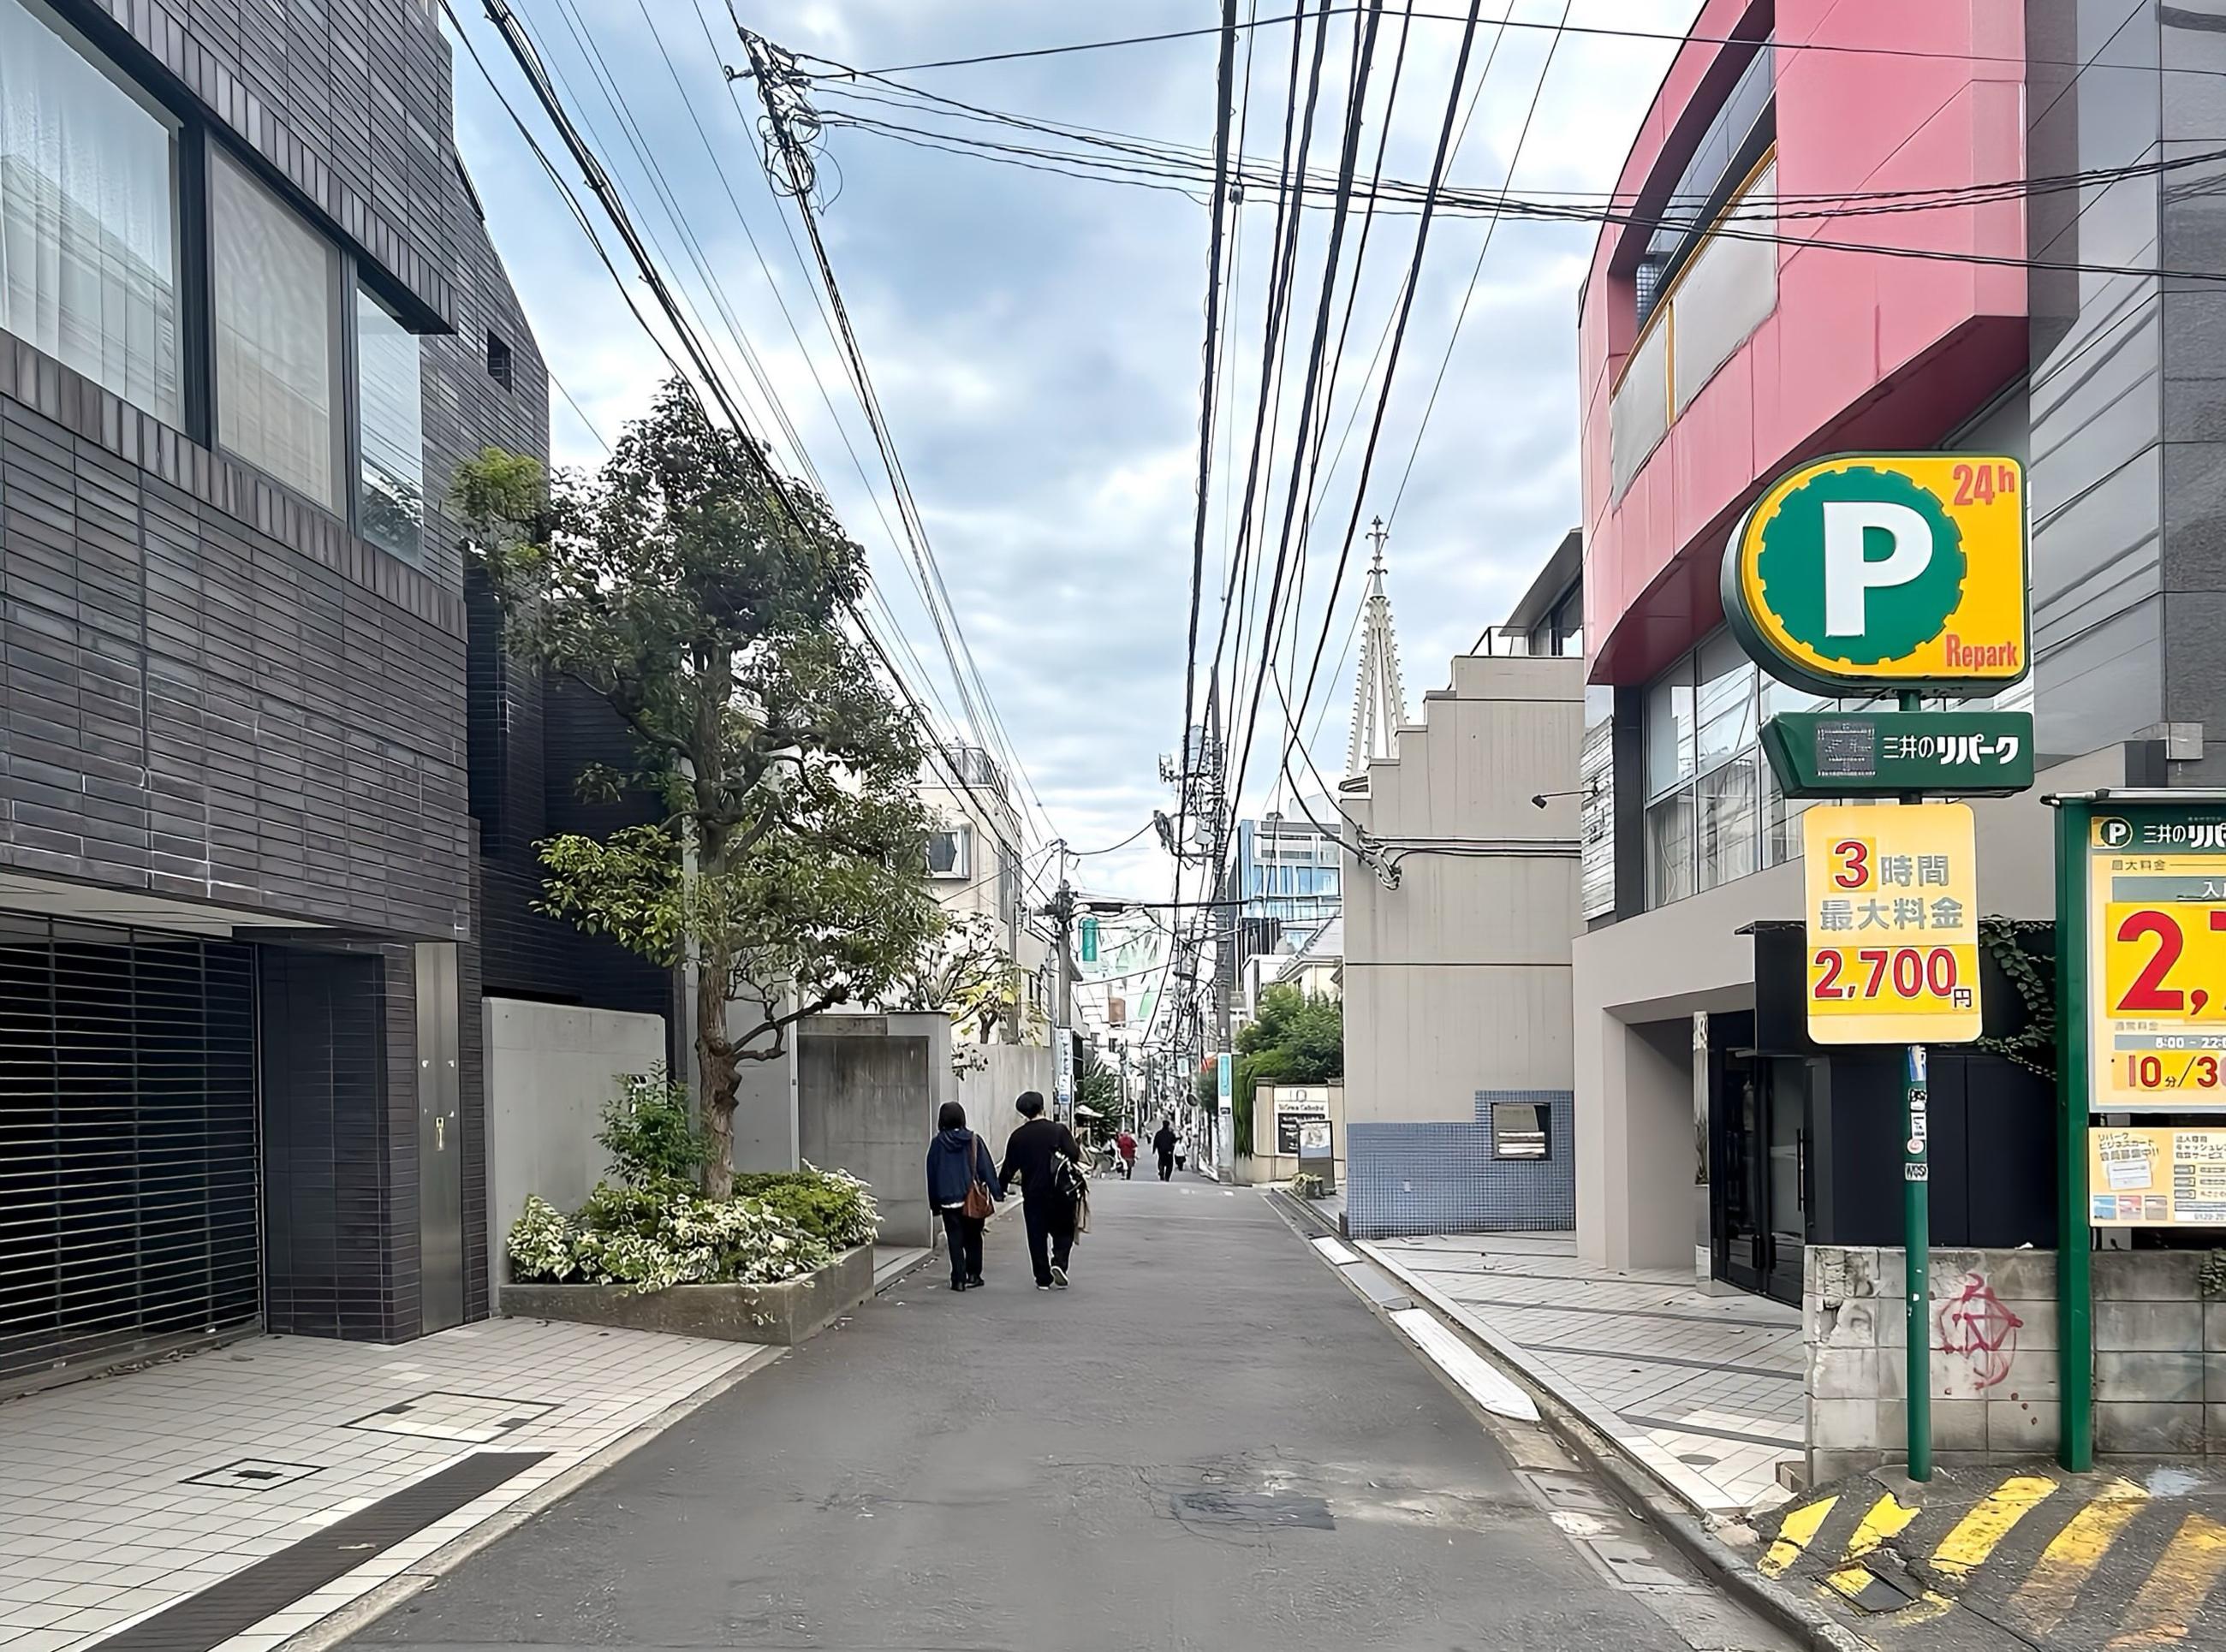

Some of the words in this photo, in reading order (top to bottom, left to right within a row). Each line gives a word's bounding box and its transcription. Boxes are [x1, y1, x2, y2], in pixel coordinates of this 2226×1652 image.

[1952, 464, 2015, 506] 24h
[1822, 501, 1933, 637] P
[1946, 634, 2018, 672] Repark
[1883, 734, 2019, 764] 三井のリパーク
[2109, 823, 2127, 843] P
[2202, 881, 2226, 898] 入
[1820, 897, 1963, 931] 最大料金
